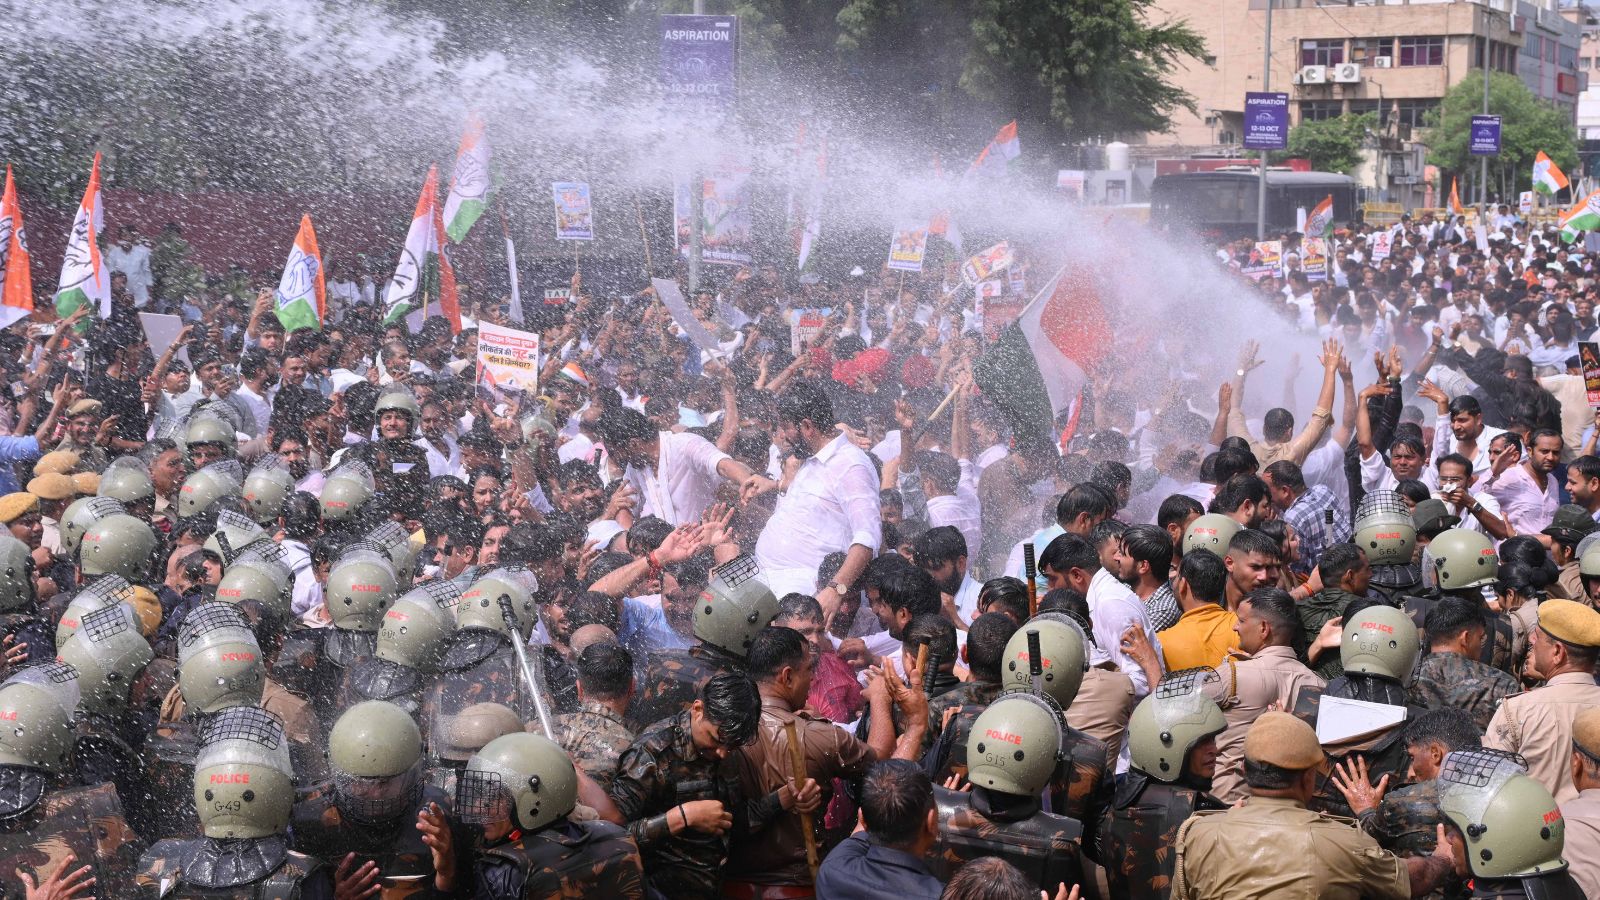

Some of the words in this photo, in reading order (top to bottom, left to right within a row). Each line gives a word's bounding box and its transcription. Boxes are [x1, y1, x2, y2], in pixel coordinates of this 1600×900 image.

[664, 30, 729, 41] ASPIRATION
[480, 343, 503, 355] लोकतंत्र
[504, 347, 512, 357] की
[512, 348, 528, 360] लूट
[1375, 532, 1401, 540] POLICE
[352, 584, 382, 593] POLICE
[1360, 621, 1395, 634] POLICE
[1017, 651, 1051, 669] POCE
[986, 729, 1023, 745] POLICE
[210, 774, 250, 784] POLICE
